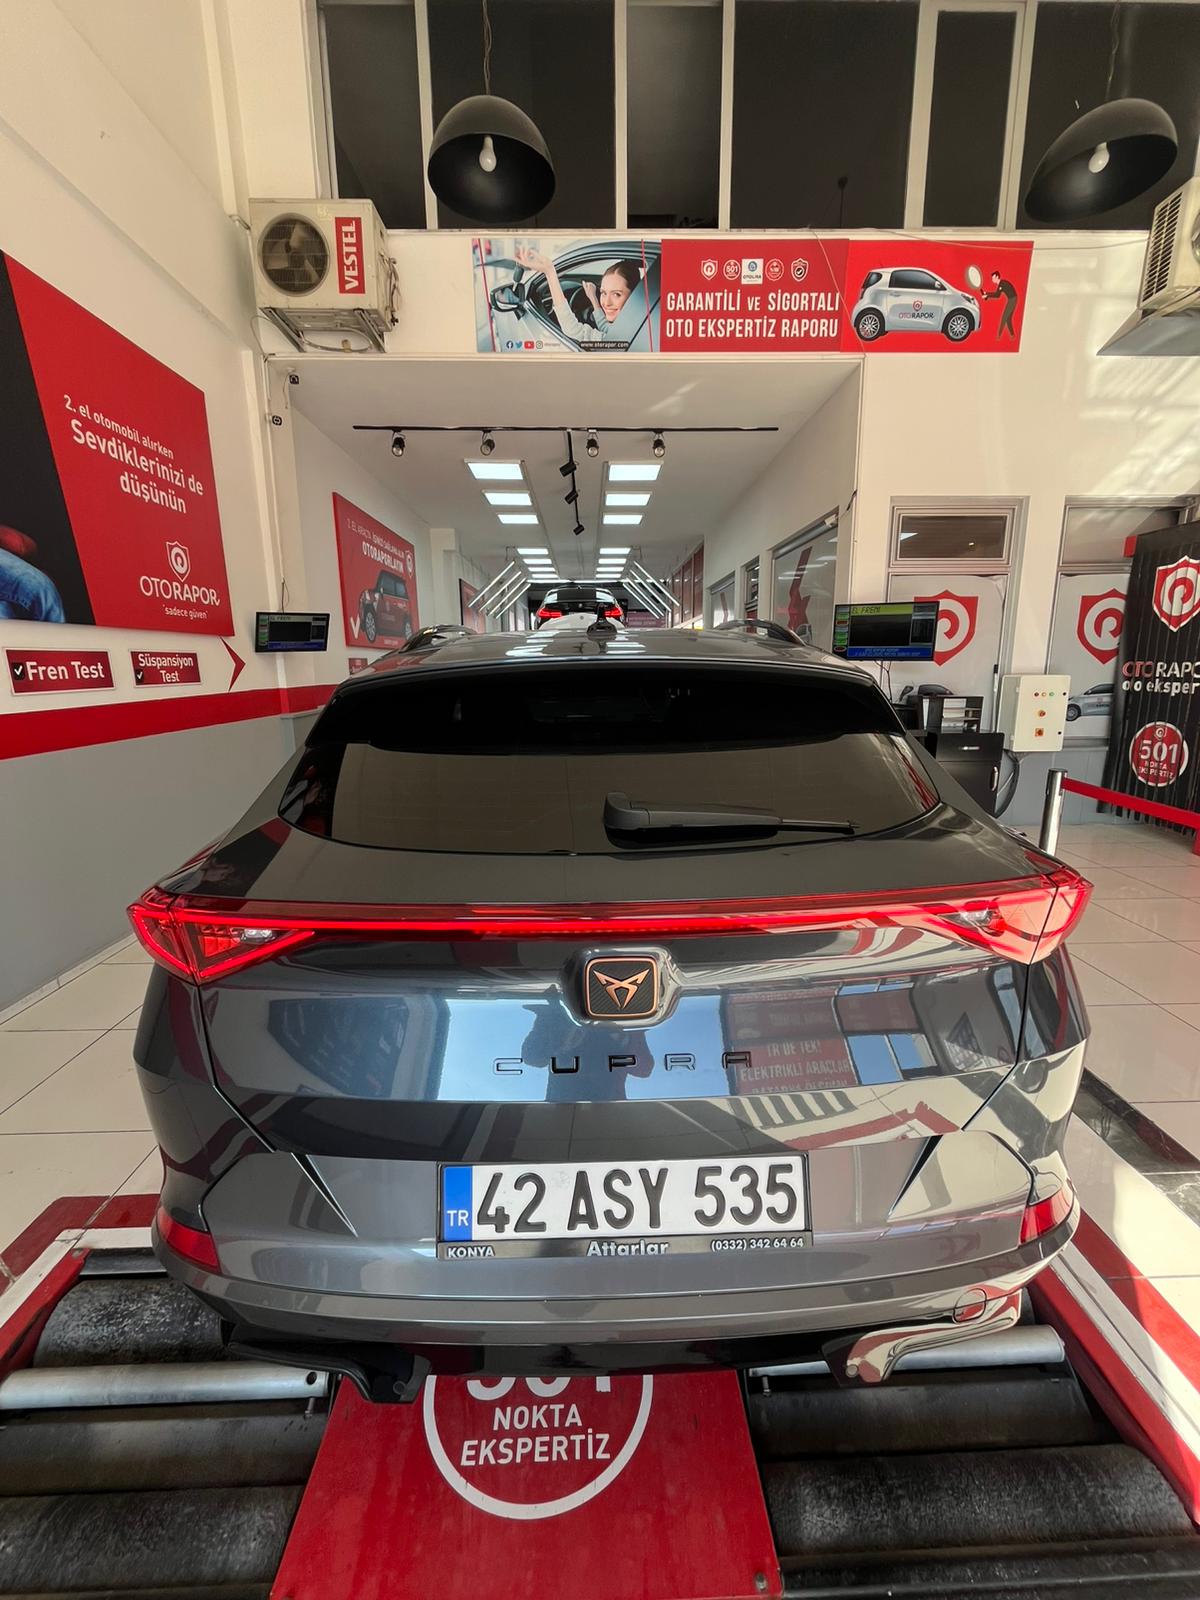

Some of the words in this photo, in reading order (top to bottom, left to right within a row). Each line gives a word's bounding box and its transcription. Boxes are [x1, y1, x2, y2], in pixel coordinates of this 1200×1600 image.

[341, 220, 360, 291] VESTEL
[666, 288, 741, 311] GARANTİLİ
[767, 288, 840, 312] SİGORTALI
[665, 318, 693, 338] OTO
[698, 315, 777, 338] EKSPERTİZ
[780, 318, 839, 338] RAPORU
[898, 311, 935, 319] OTORAPOR
[63, 394, 77, 413] 2.
[79, 404, 92, 420] el
[93, 412, 141, 444] otomobil
[141, 434, 175, 460] alırken
[70, 418, 187, 489] Sevdiklerinizi
[187, 474, 204, 496] de
[119, 471, 187, 514] düşünün
[139, 575, 220, 607] OTORAPOR
[25, 661, 69, 681] Fren
[70, 660, 105, 679] Test
[138, 653, 195, 669] Süspansiyon
[159, 669, 180, 683] Test
[1140, 739, 1179, 765] 501
[492, 1051, 752, 1075] CUPRA
[476, 1171, 547, 1234] 42
[567, 1166, 670, 1231] ASY
[694, 1163, 798, 1228] 535
[446, 1209, 470, 1228] TR
[447, 1245, 496, 1259] KONYA
[586, 1238, 669, 1257] Attarlar
[710, 1239, 748, 1252] (0332)
[749, 1238, 770, 1249] 342
[773, 1237, 787, 1248] 64
[790, 1237, 804, 1248] 64
[493, 1403, 583, 1431] NOKTA
[460, 1428, 611, 1467] EKSPERTİZ
